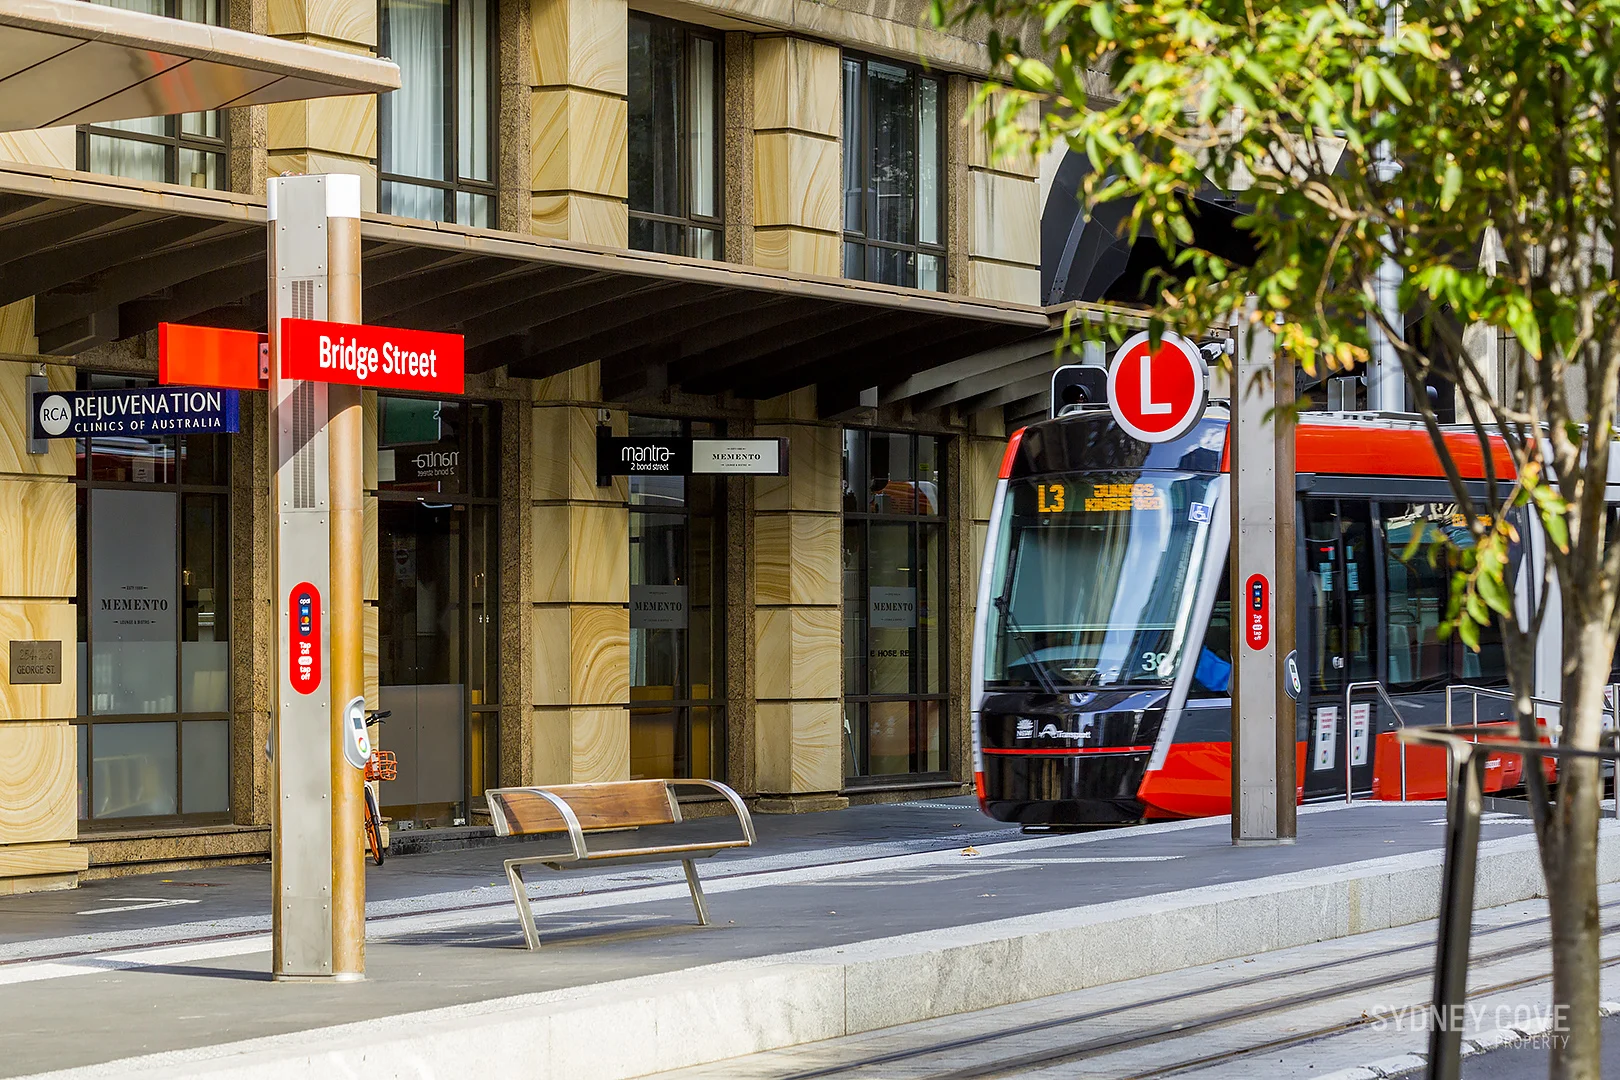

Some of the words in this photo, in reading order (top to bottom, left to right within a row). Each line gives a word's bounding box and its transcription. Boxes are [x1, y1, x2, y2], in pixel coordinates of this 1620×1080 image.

[319, 335, 379, 380] Bridge
[382, 342, 438, 378] Street
[1140, 355, 1172, 415] L
[74, 391, 221, 420] REJUVENATION
[43, 408, 69, 421] RCA
[74, 421, 124, 432] CLINICS
[130, 420, 145, 431] OF
[151, 417, 221, 430] AUSTRALIA
[621, 444, 675, 462] mantra
[630, 463, 636, 471] 2
[636, 462, 652, 471] bond
[652, 462, 670, 471] street
[1038, 484, 1065, 513] L3
[101, 598, 168, 611] MEMENTO
[634, 601, 682, 611] MEMENTO
[873, 602, 913, 612] MEMENTO
[298, 641, 311, 649] Tap
[877, 649, 898, 658] HOSE
[899, 649, 910, 657] RE
[16, 664, 44, 675] GEORGE
